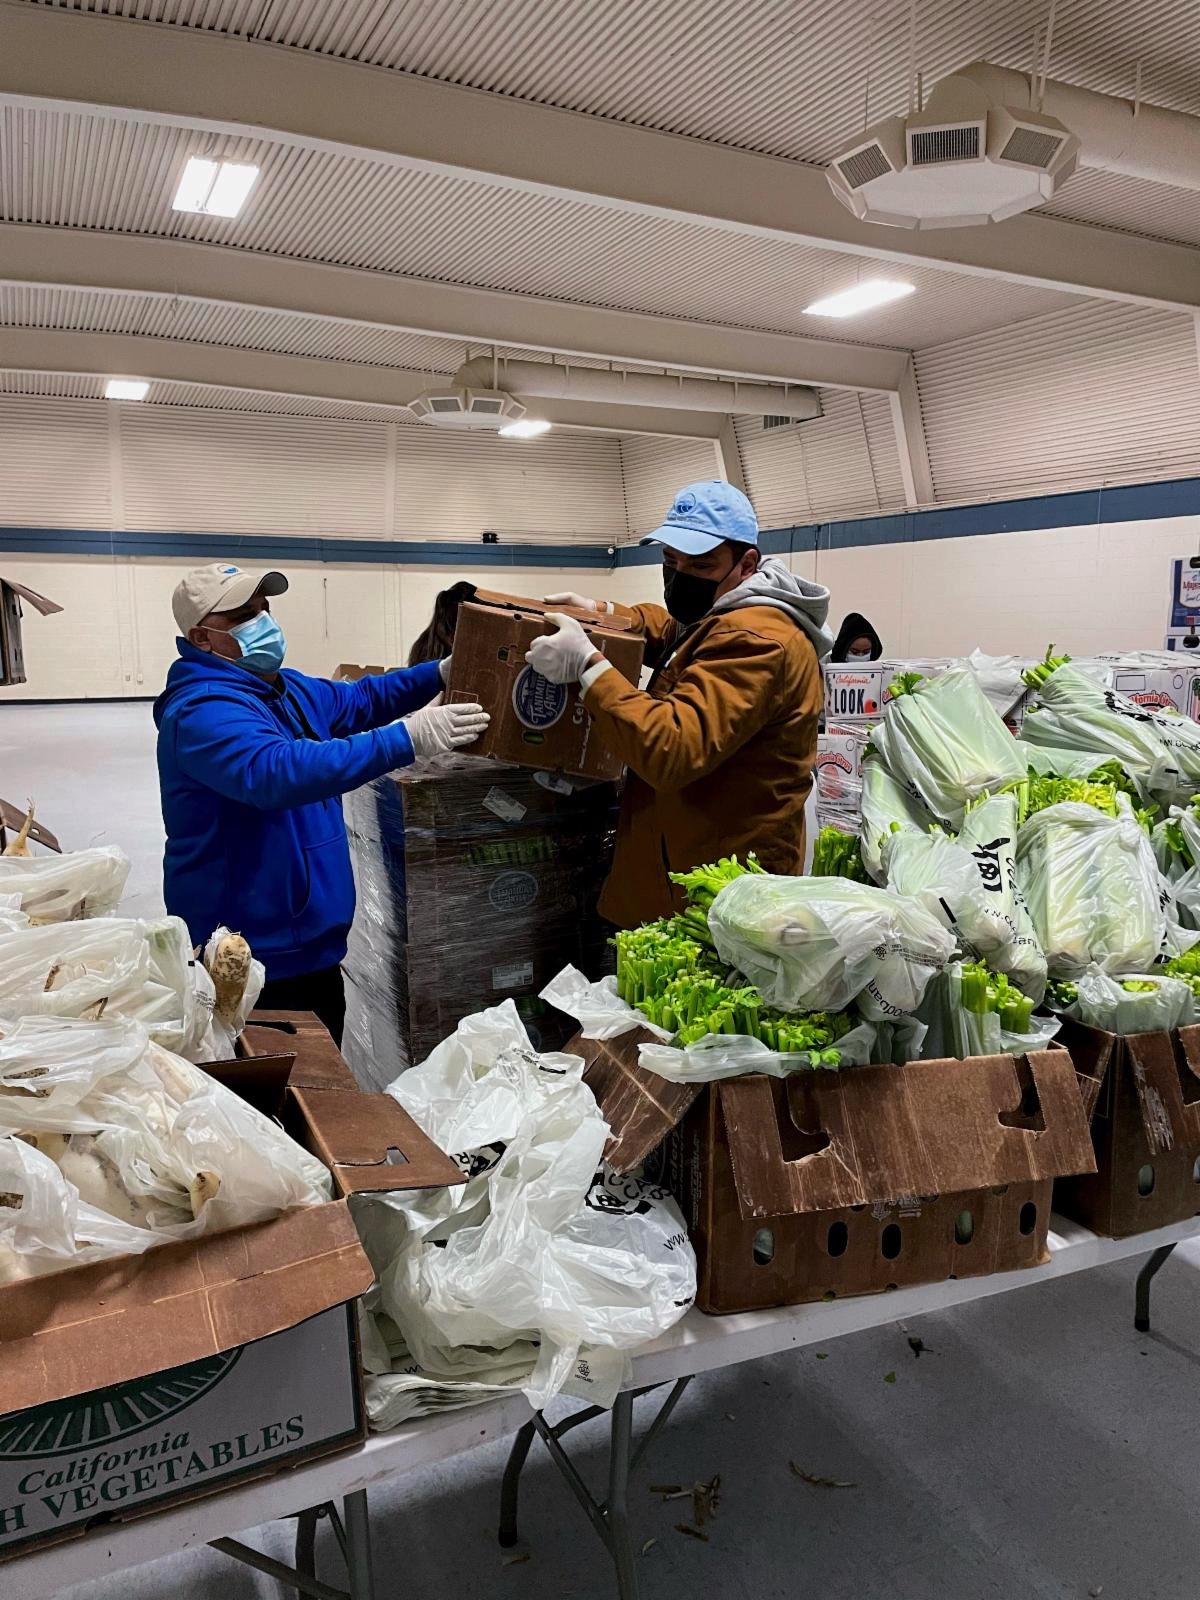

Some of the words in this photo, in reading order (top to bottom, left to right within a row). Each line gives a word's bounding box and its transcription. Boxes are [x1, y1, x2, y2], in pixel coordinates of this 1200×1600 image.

[834, 688, 865, 714] LOOK
[18, 1431, 190, 1495] California
[40, 1414, 305, 1519] VEGETABLES
